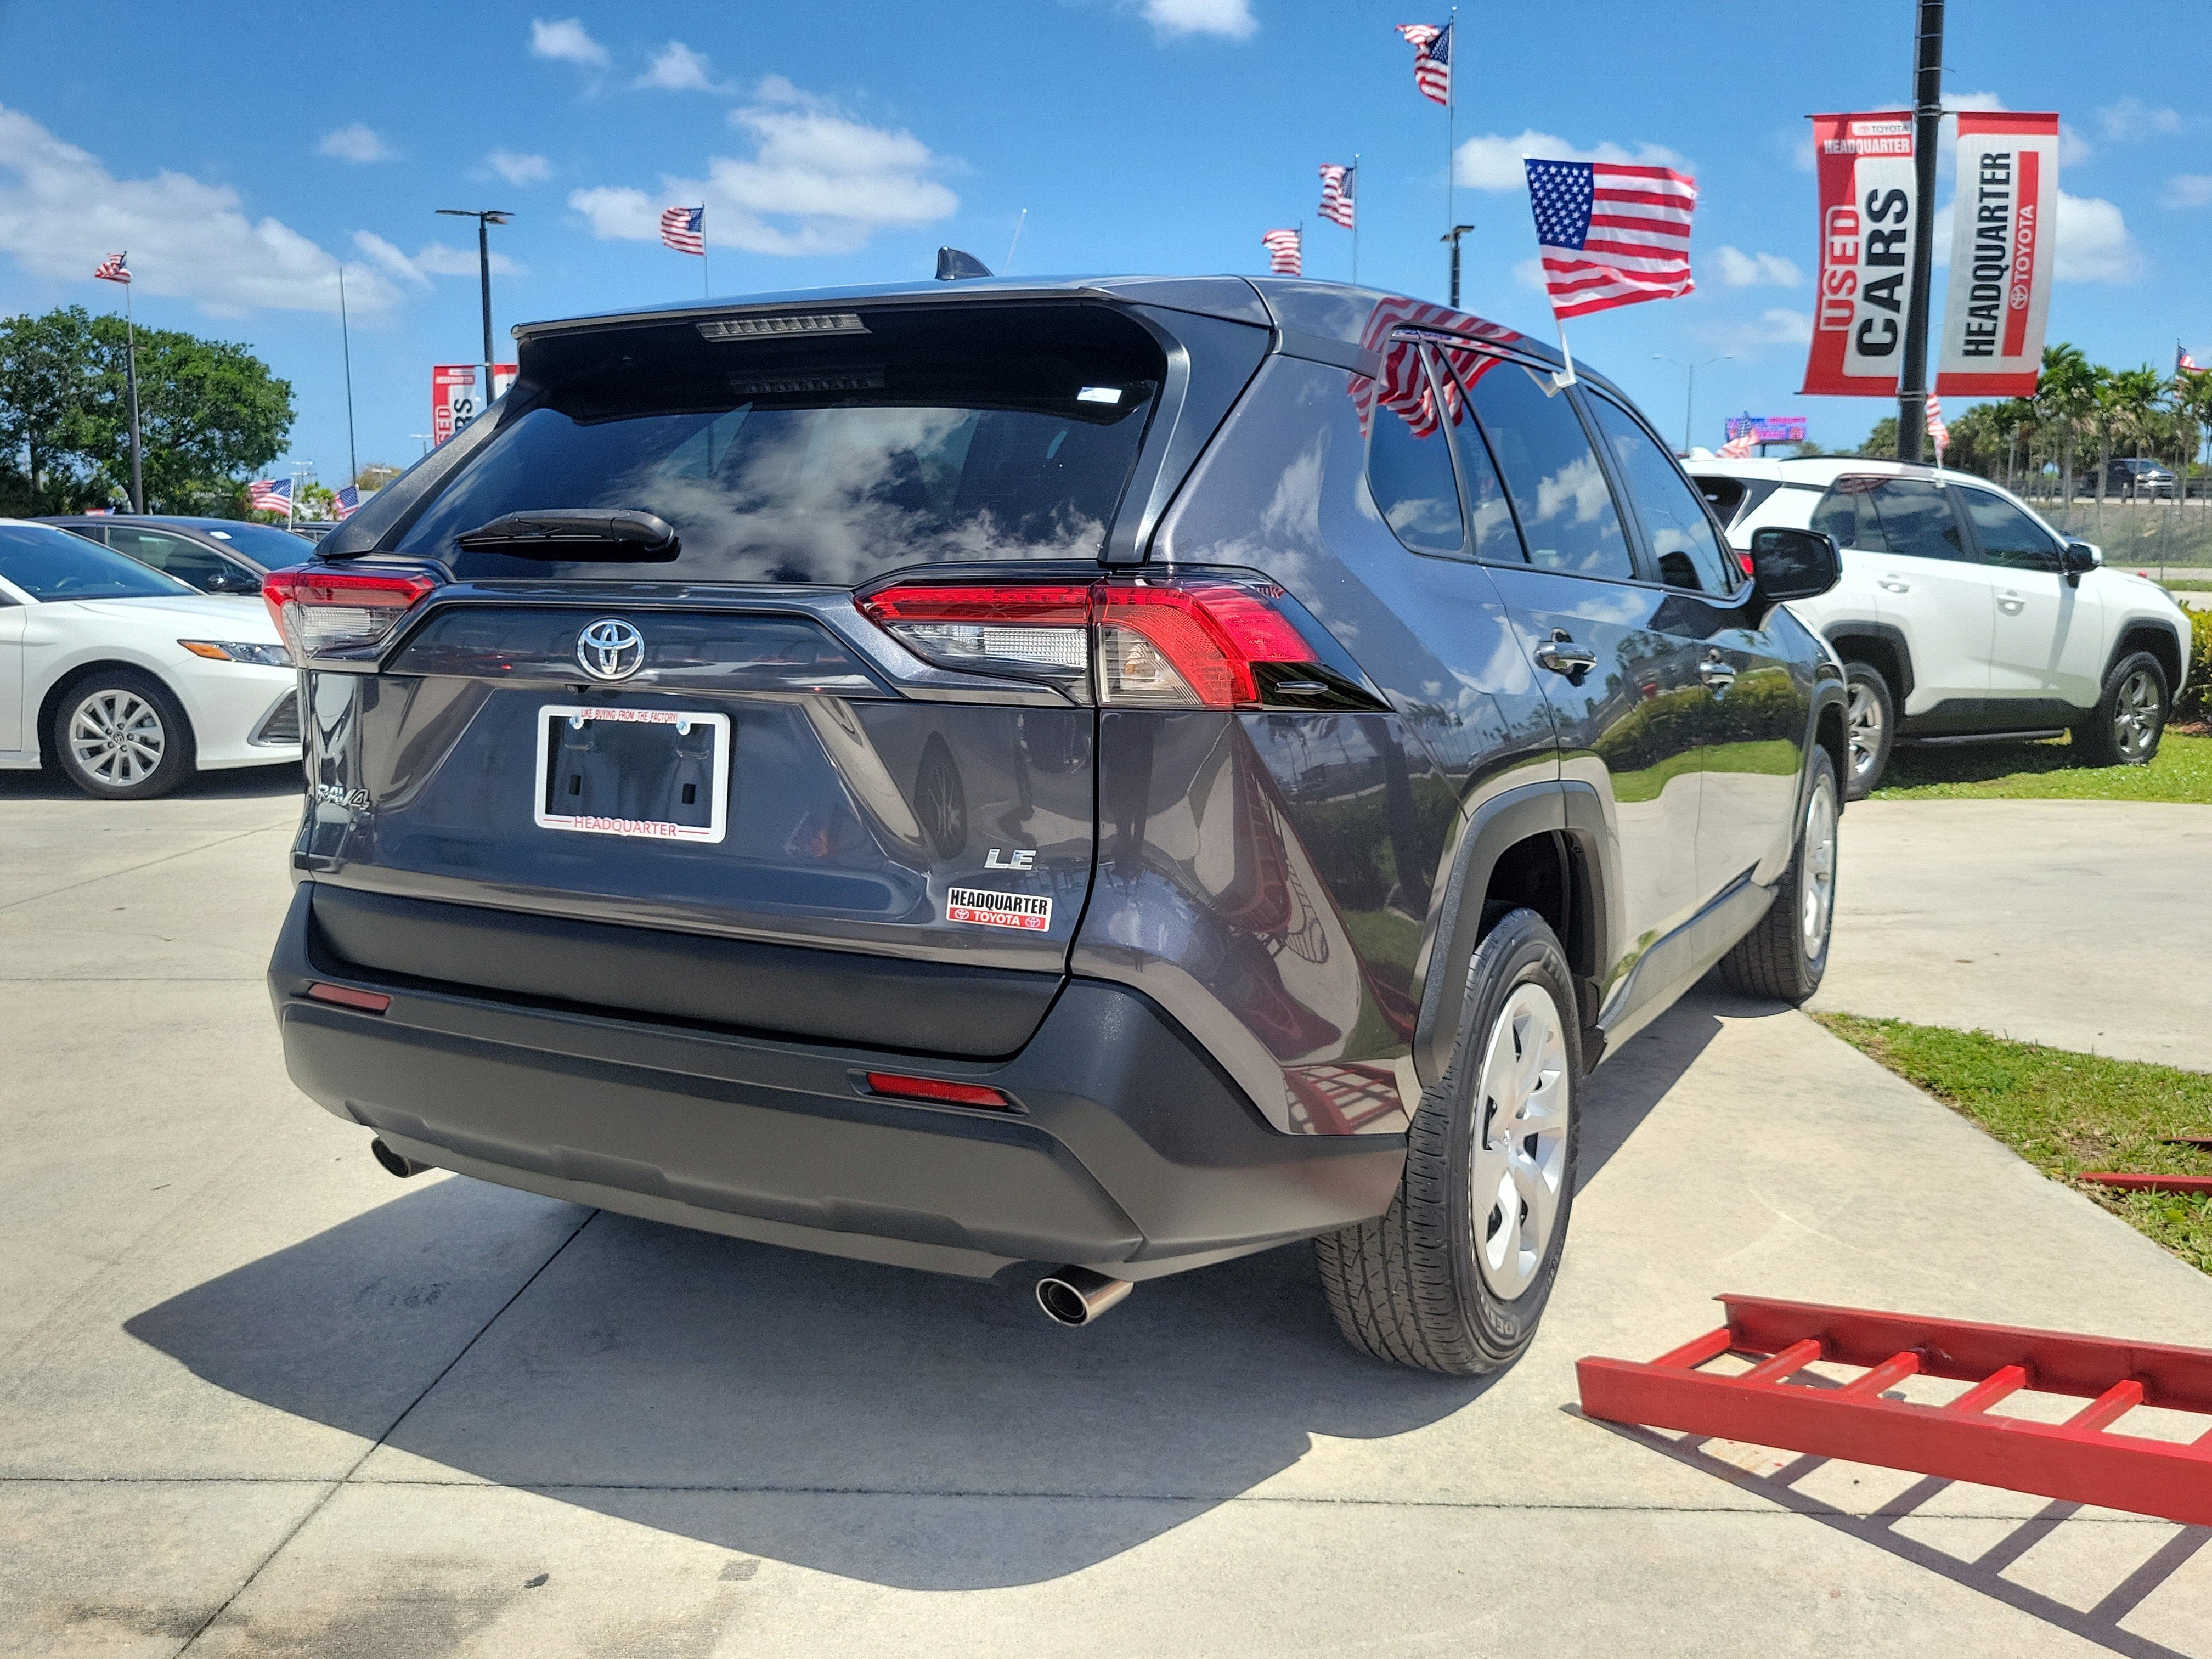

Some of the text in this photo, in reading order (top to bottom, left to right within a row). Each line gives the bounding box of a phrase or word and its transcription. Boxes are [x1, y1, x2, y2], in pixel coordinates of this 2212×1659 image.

[1872, 125, 1909, 133] TOYOTA
[1824, 138, 1910, 155] HEADQUARTER
[1962, 152, 2010, 357] HEADQUARTER
[2015, 205, 2034, 281] TOYOTA
[1822, 207, 1859, 329] USED
[1855, 188, 1908, 357] CARS
[438, 408, 452, 444] SED
[454, 398, 473, 431] RS
[581, 709, 678, 723] LIKE BUYING FROM THE FACTORY!
[317, 783, 371, 810] RAV4
[574, 816, 676, 837] HEADQUARTER
[984, 848, 1037, 870] LE
[950, 889, 1048, 915] HEADQUARTER
[973, 911, 1021, 926] TOYOTA
